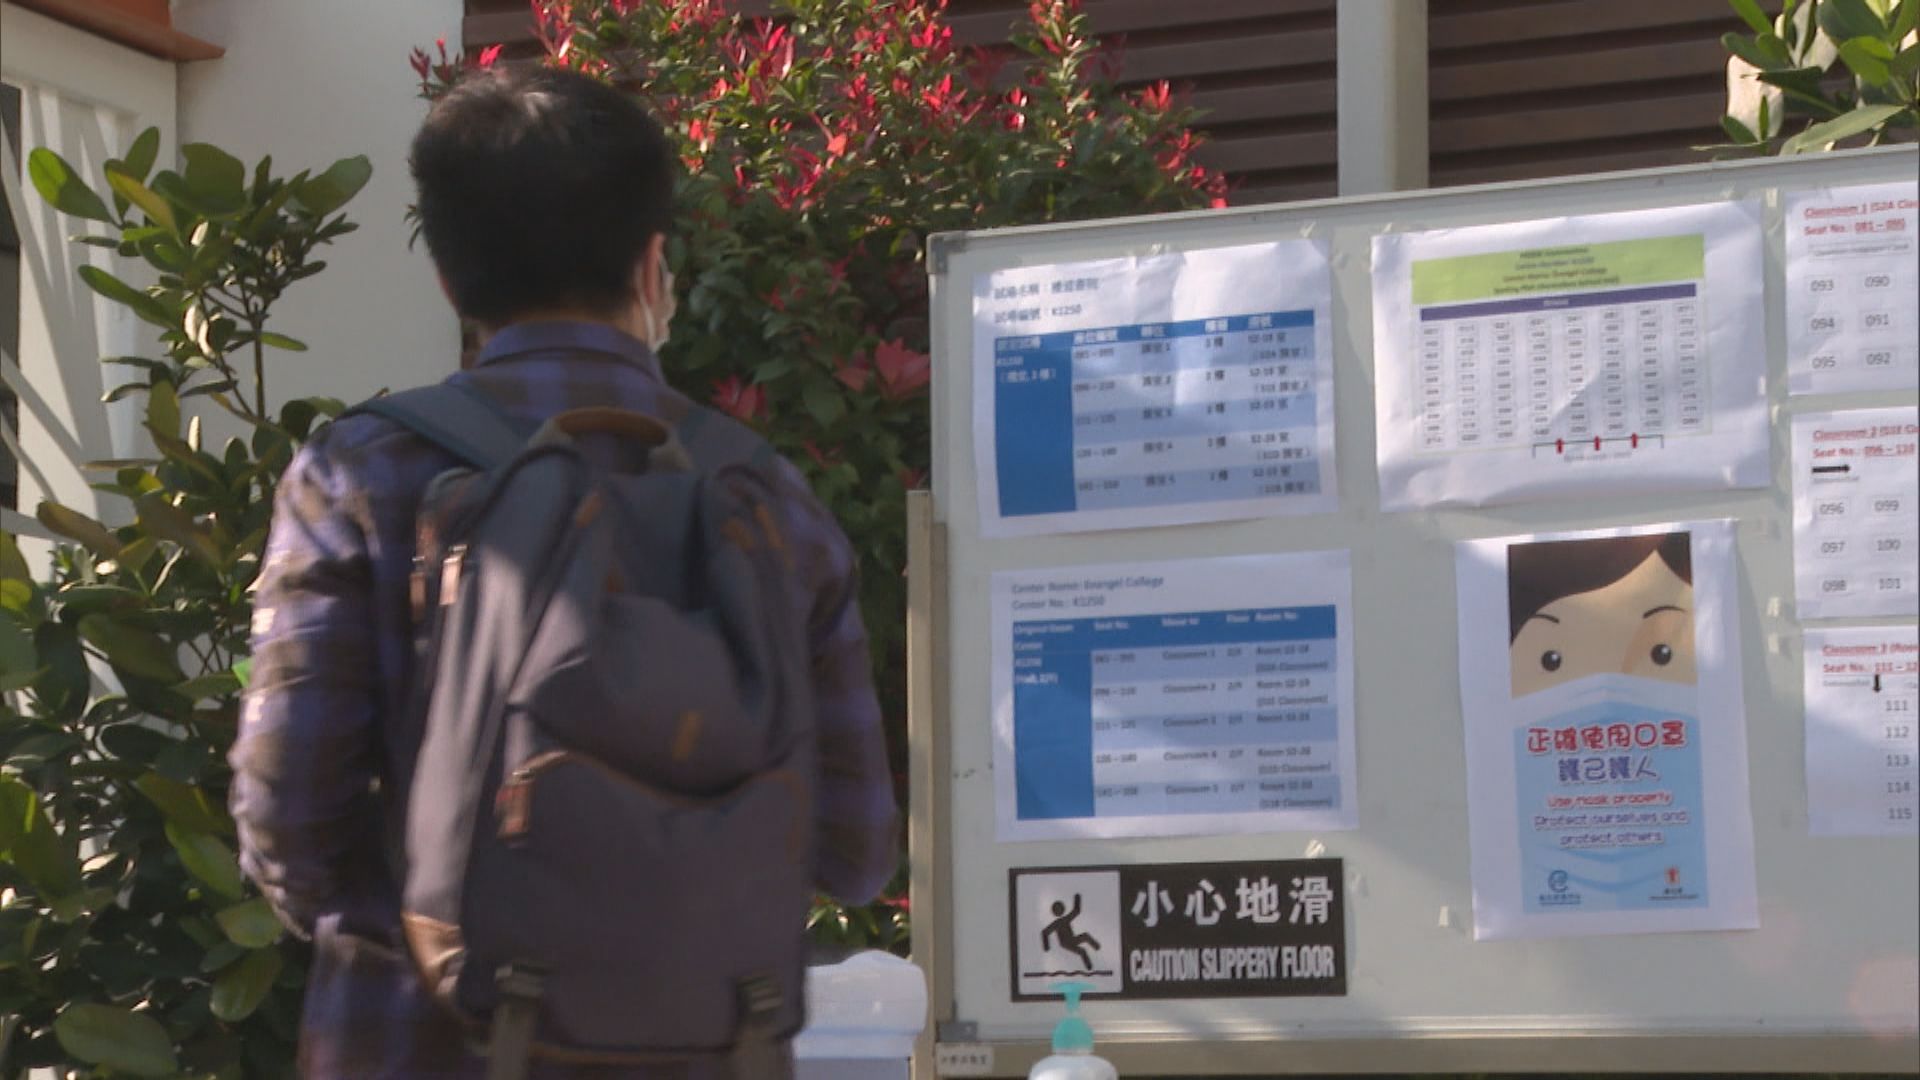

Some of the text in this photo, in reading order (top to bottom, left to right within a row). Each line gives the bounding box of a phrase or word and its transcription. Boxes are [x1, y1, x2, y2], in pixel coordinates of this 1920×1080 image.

[1805, 226, 1826, 236] Seat
[1810, 280, 1834, 292] 093
[1864, 276, 1890, 288] 090
[1811, 318, 1835, 330] 094
[1865, 314, 1889, 326] 091
[1812, 356, 1836, 369] 095
[1866, 353, 1891, 365] 092
[1813, 448, 1835, 459] Seat
[1820, 503, 1844, 515] 096
[1875, 500, 1899, 511] 099
[1821, 542, 1846, 553] 097
[1877, 540, 1901, 551] 100
[1822, 580, 1847, 592] 098
[1879, 578, 1901, 590] 101
[1823, 663, 1846, 673] Seat
[1886, 700, 1908, 711] 111
[1527, 720, 1685, 754] 正確使用口罩
[1886, 726, 1909, 738] 112
[1887, 755, 1910, 767] 113
[1558, 756, 1660, 783] 護己護人
[1887, 782, 1911, 793] 114
[1548, 792, 1672, 807] Use mask properly
[1592, 811, 1657, 825] ourselves
[1661, 810, 1687, 822] and
[1889, 808, 1912, 819] 115
[1560, 832, 1611, 847] protect
[1132, 876, 1333, 928] 小心地滑
[1130, 946, 1335, 982] CAUTION SLIPPERY FLOOR
